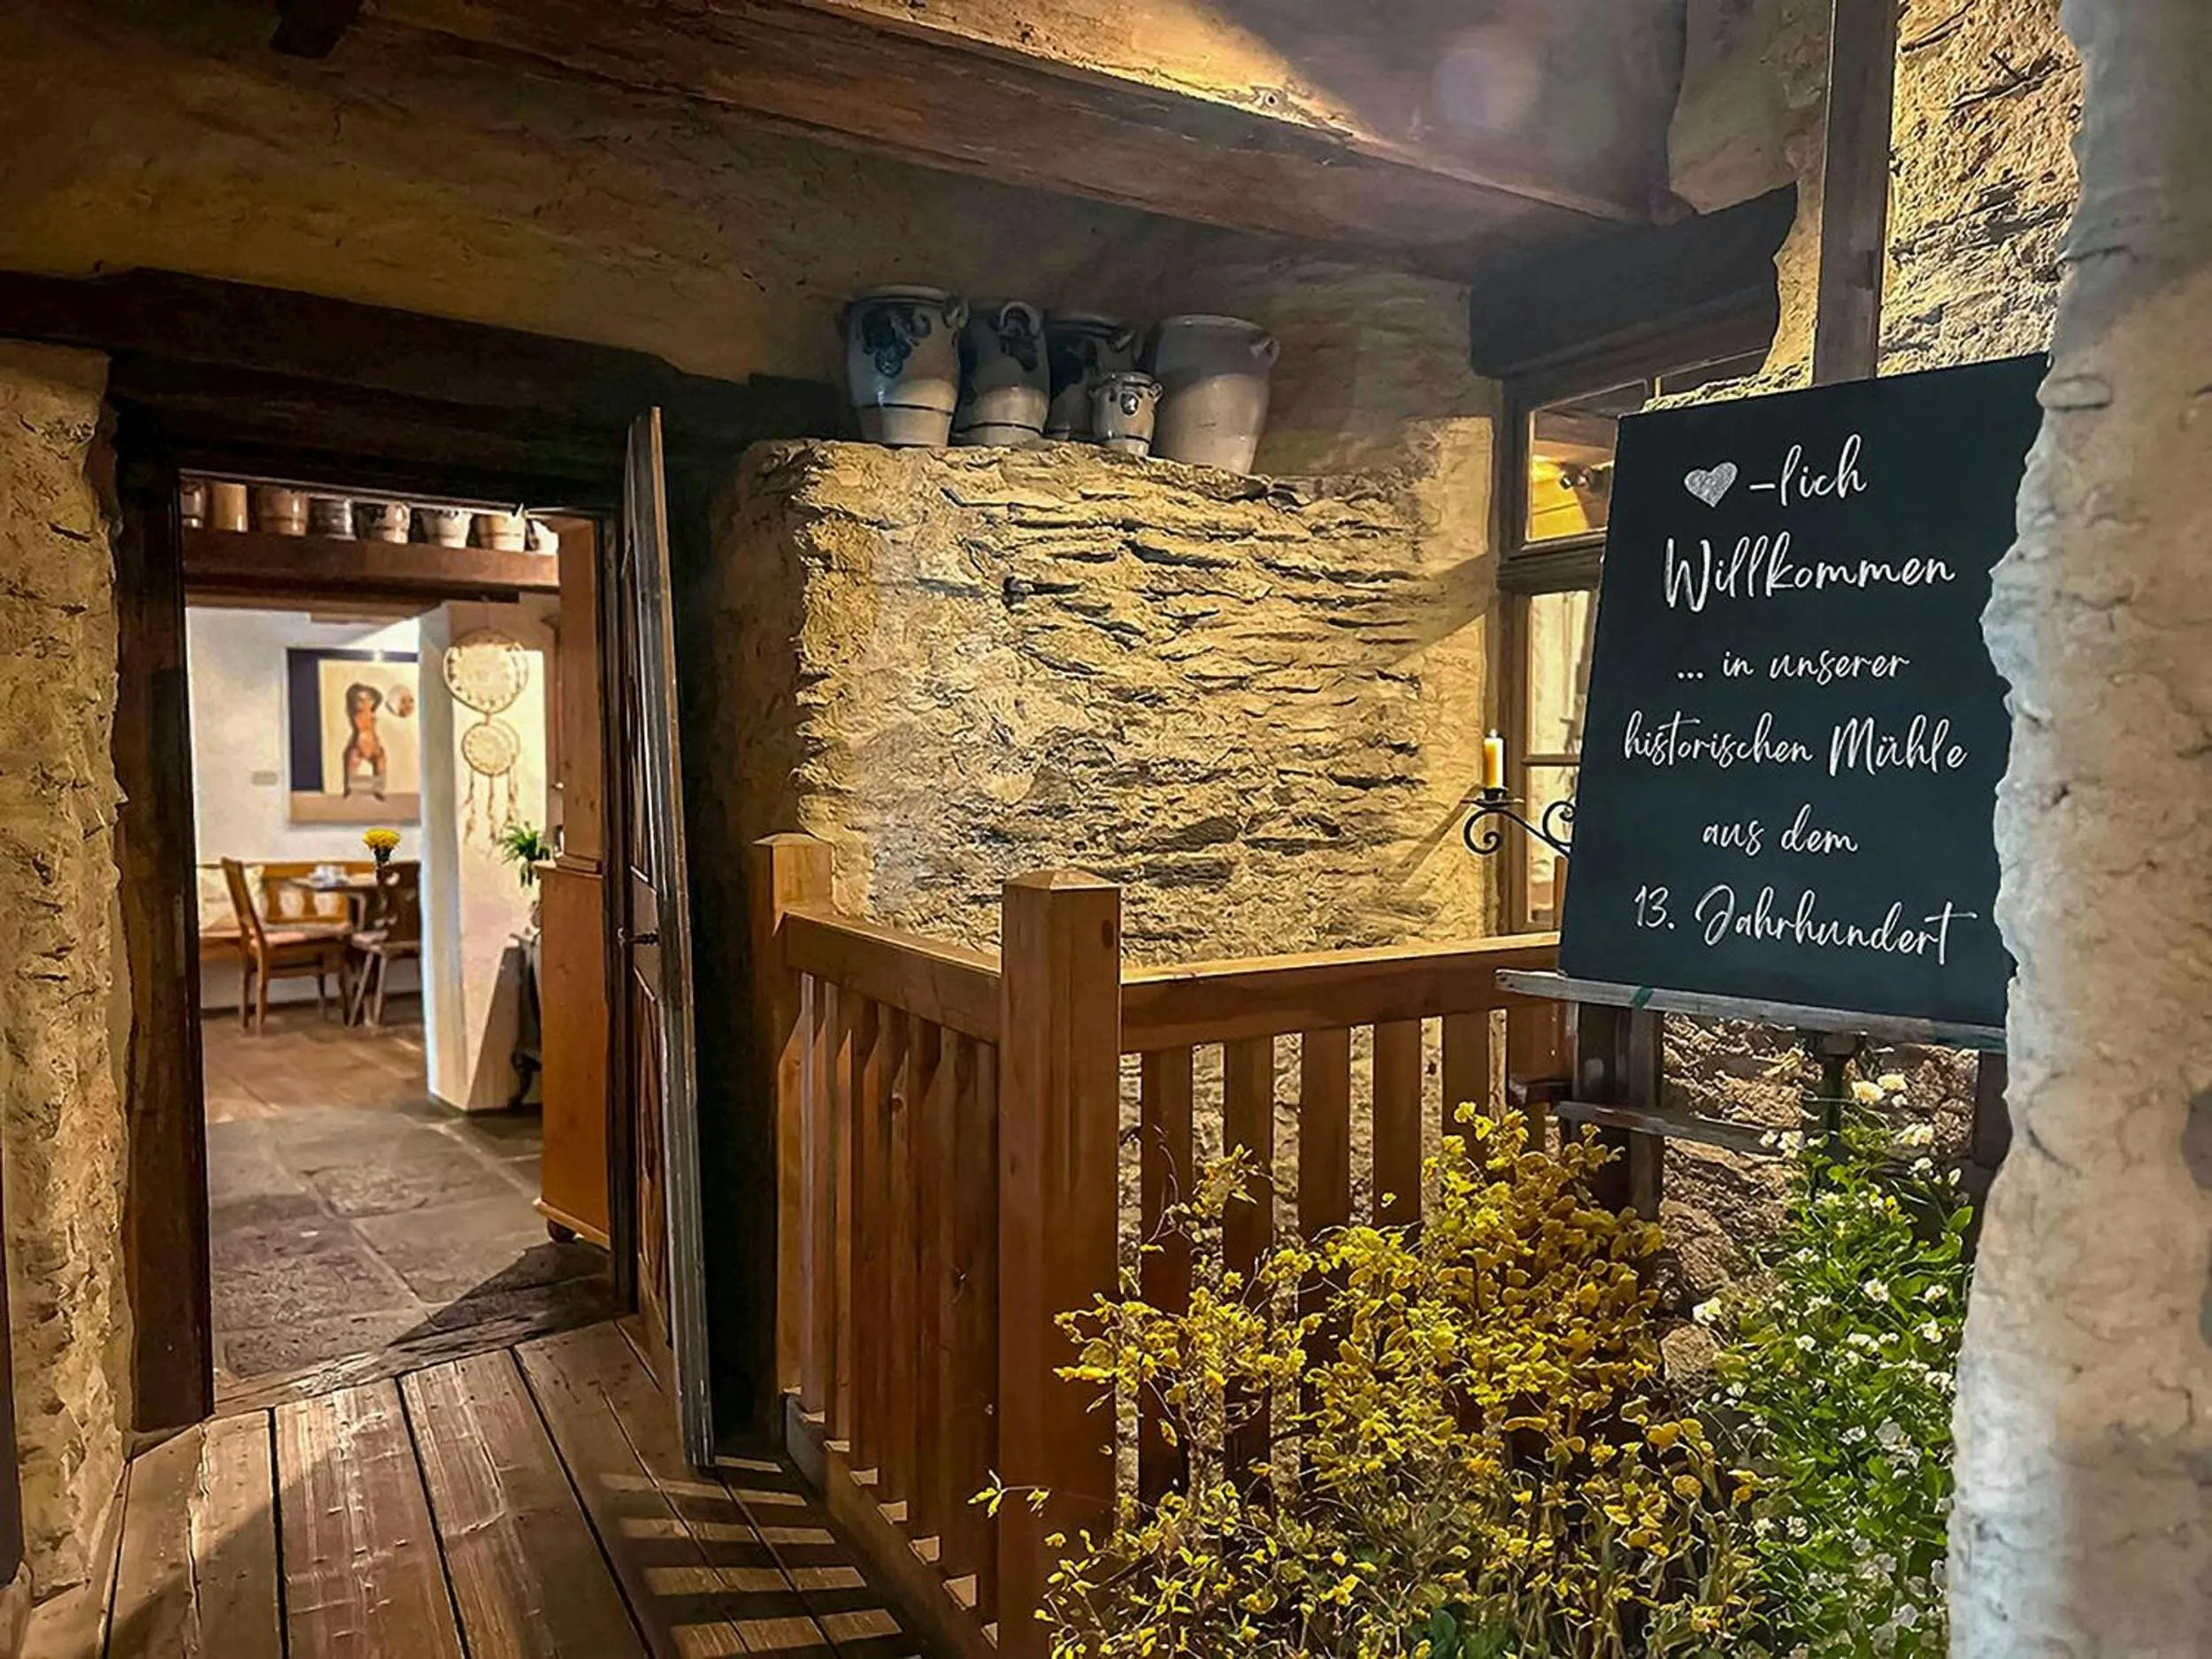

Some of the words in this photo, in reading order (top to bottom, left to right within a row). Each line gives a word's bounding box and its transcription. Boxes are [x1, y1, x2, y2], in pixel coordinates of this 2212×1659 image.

[1665, 530, 1956, 612] Willkommen
[1723, 650, 1755, 678] in
[1769, 649, 1910, 686] unserer
[1624, 710, 1814, 769] historischen
[1829, 714, 1968, 777] Mühle
[1702, 819, 1765, 856] aus
[1780, 803, 1859, 854] dem
[1634, 885, 1675, 930] 13.
[1694, 884, 1978, 965] Jahrhundert
